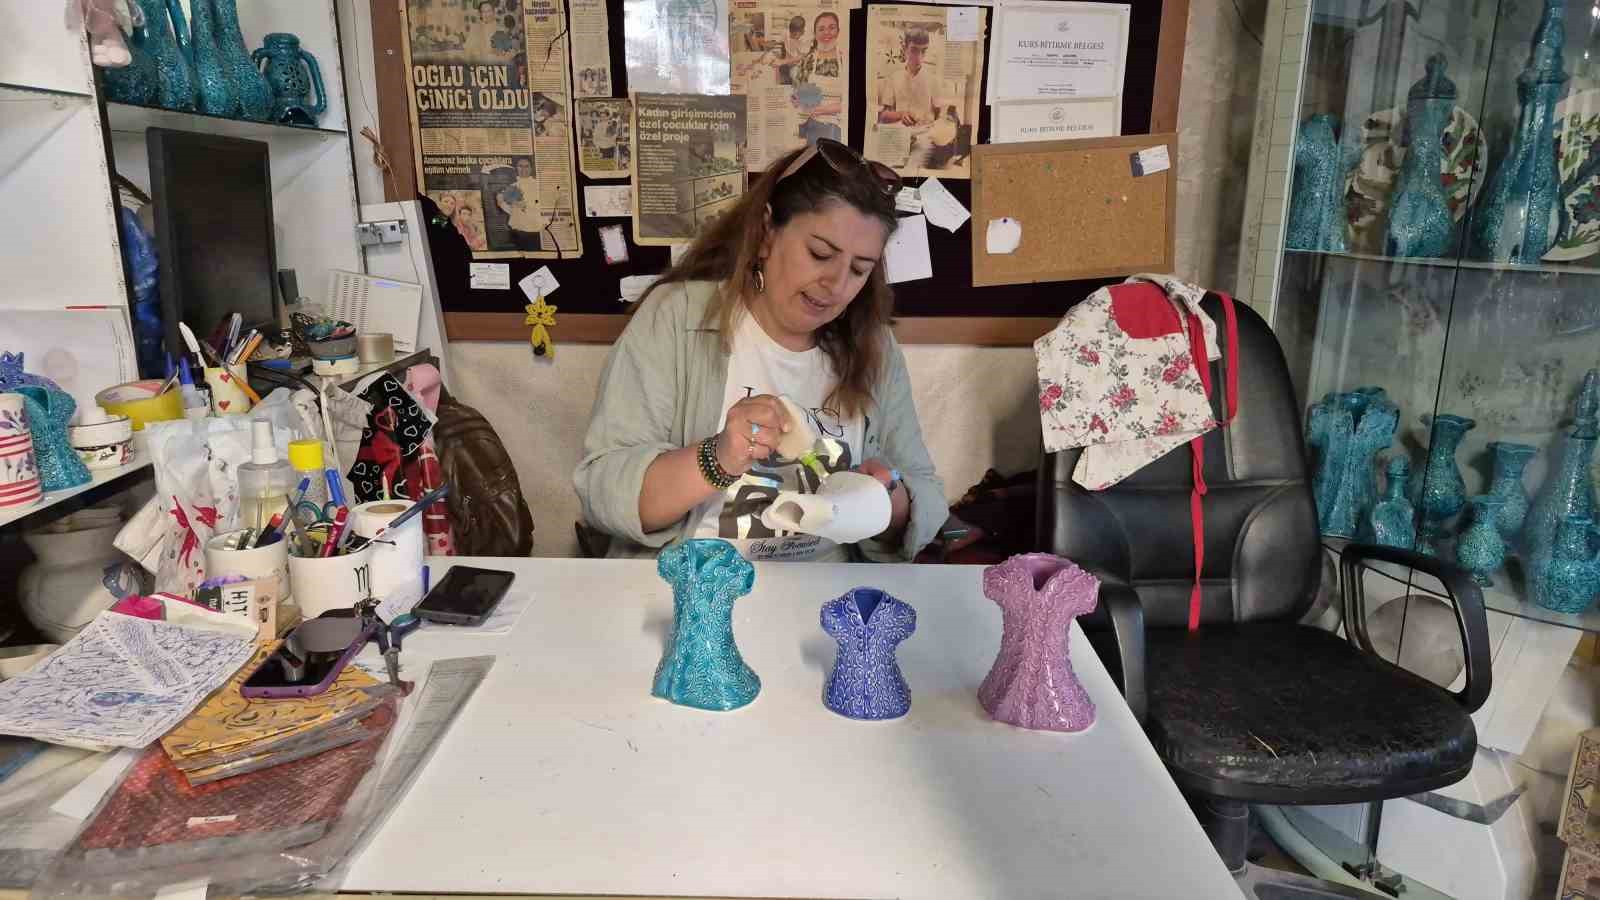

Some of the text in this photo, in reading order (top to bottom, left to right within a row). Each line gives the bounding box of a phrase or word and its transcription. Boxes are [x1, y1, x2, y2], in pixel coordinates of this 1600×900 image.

[478, 89, 529, 109] OLDU
[639, 119, 661, 129] özel
[662, 120, 709, 132] çocuklar
[639, 131, 690, 144] özel proje
[750, 540, 777, 554] Stay
